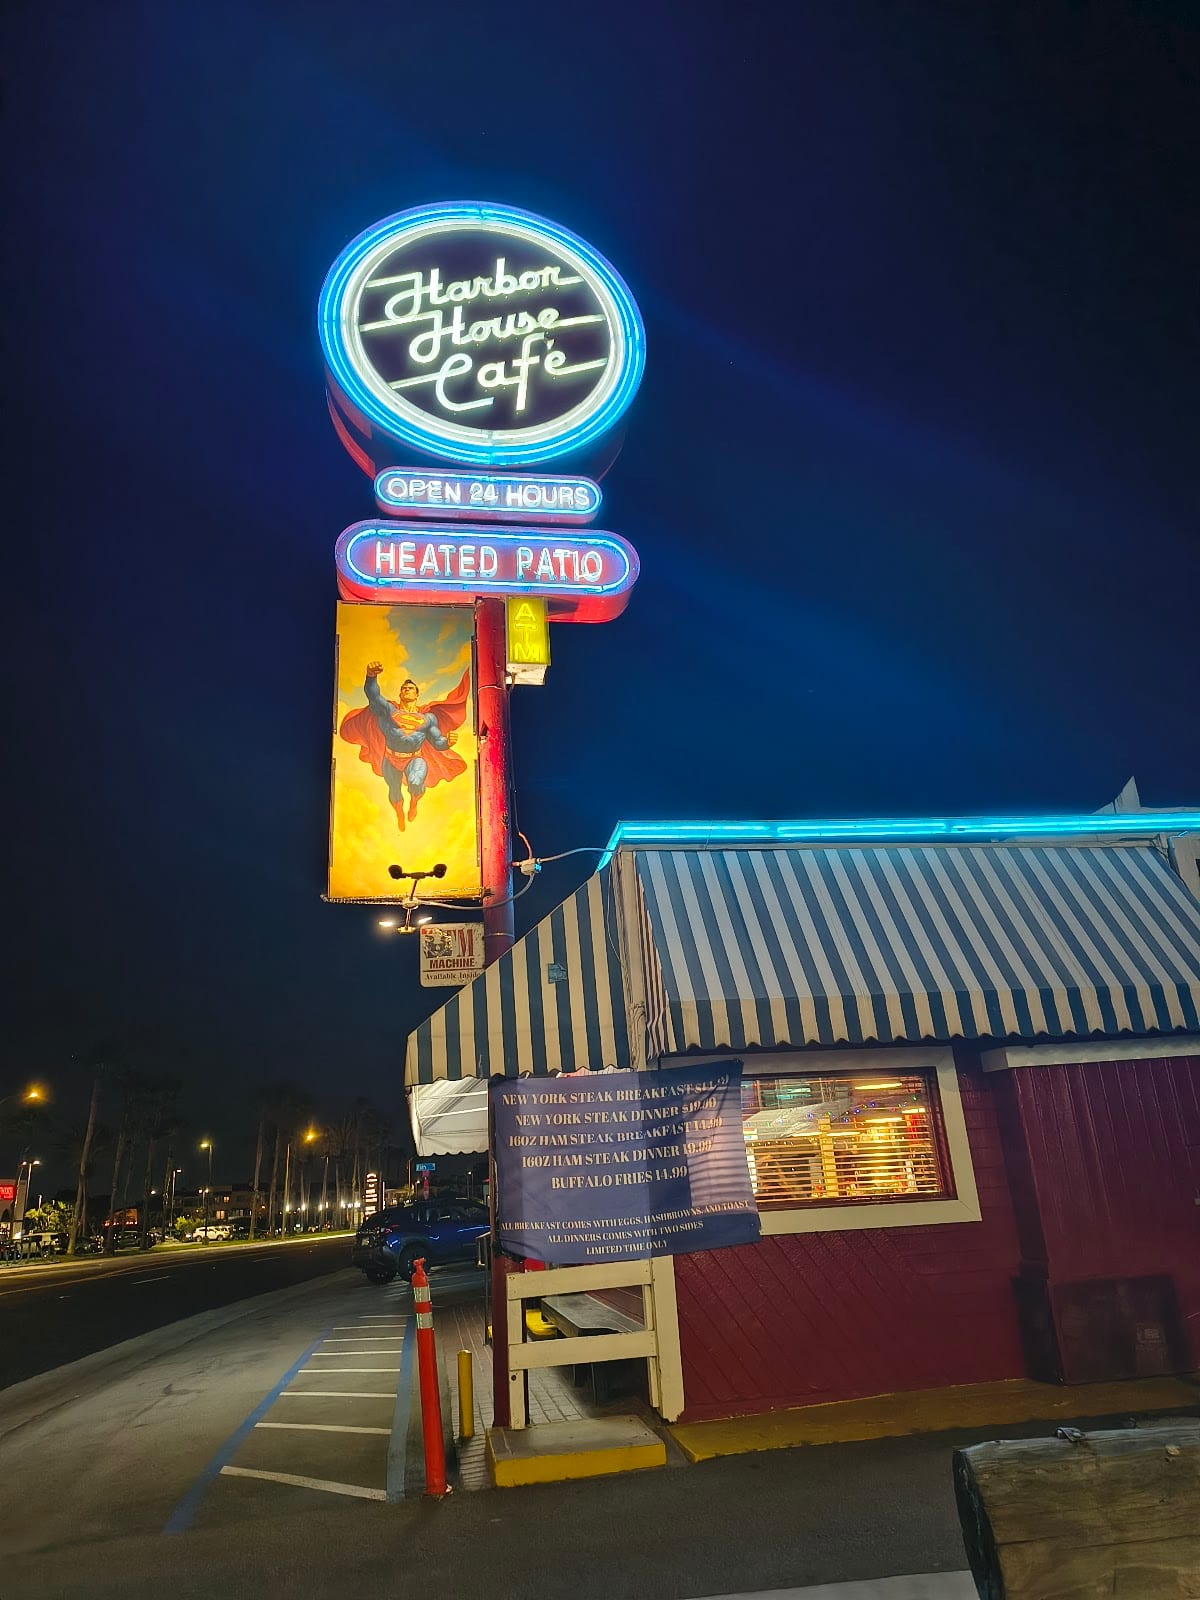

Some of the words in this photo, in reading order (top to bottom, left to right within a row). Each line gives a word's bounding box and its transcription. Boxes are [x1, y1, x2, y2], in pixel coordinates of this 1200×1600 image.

[372, 256, 578, 323] Harbor
[384, 306, 586, 364] House
[387, 477, 461, 504] OPEN
[469, 482, 498, 504] 24
[506, 484, 591, 507] HOURS
[375, 541, 498, 577] HEATED
[515, 546, 603, 582] PATIO
[514, 603, 541, 661] ATM
[430, 958, 475, 969] MACHINE
[502, 1094, 528, 1105] NEW
[532, 1093, 567, 1105] YORK
[569, 1091, 613, 1103] STEAK
[616, 1083, 692, 1101] BREAKFAST
[515, 1114, 544, 1126] NEW
[545, 1113, 581, 1125] YORK
[584, 1111, 628, 1124] STEAK
[632, 1106, 679, 1121] DINNER
[539, 1134, 568, 1146] HAM
[569, 1133, 613, 1145] STEAK
[617, 1121, 691, 1142] BREAKFAST
[553, 1154, 582, 1167] HAM
[585, 1151, 630, 1165] STEAK
[632, 1144, 680, 1160] DINNER
[551, 1174, 612, 1189] BUFFALO
[615, 1170, 653, 1186] FRIES
[501, 1222, 514, 1231] ALL
[514, 1221, 560, 1231] BREAKFAST
[562, 1220, 592, 1230] COMES
[592, 1218, 617, 1228] WITH
[704, 1203, 721, 1213] AND
[722, 1200, 750, 1211] TOAST
[548, 1234, 563, 1243] ALL
[564, 1233, 601, 1243] DINNERS
[602, 1231, 633, 1241] COMES
[634, 1227, 658, 1238] WITH
[660, 1225, 679, 1235] TWO
[680, 1220, 704, 1232] SIDES
[586, 1245, 622, 1255] LIMITED
[624, 1242, 645, 1253] TIME
[646, 1239, 668, 1250] ONLY
